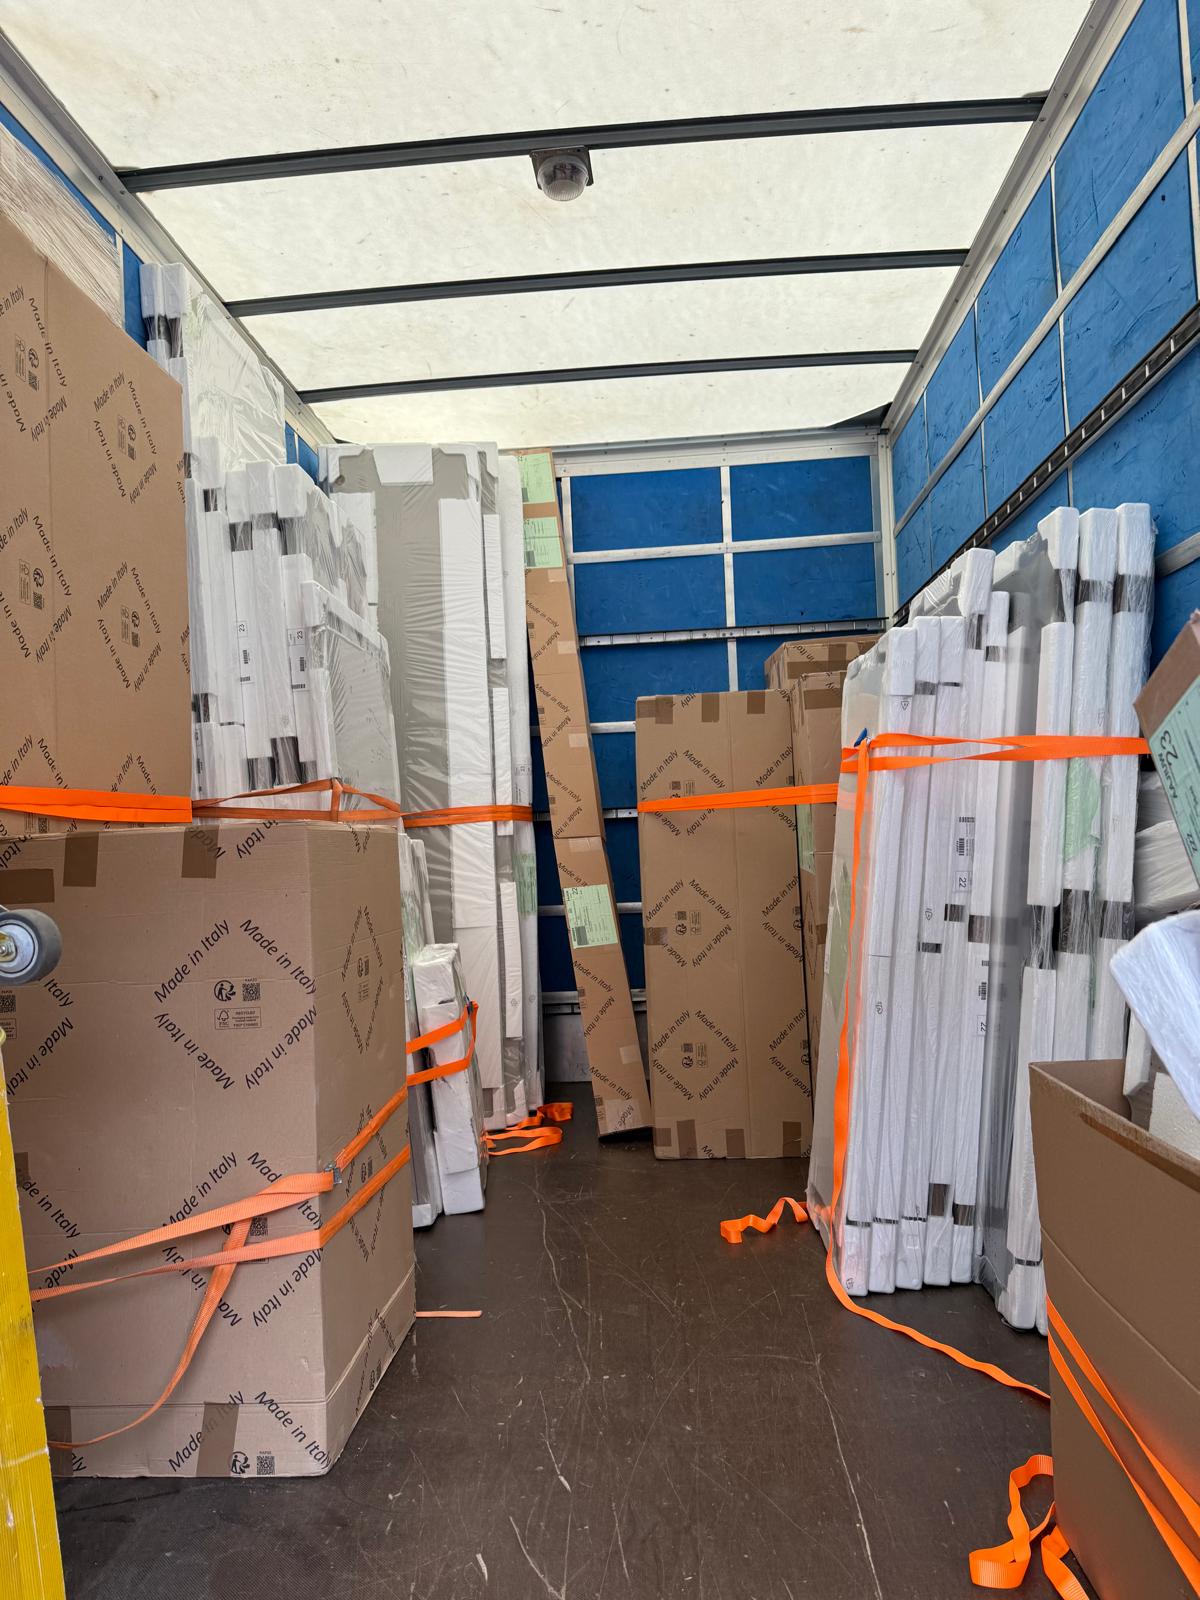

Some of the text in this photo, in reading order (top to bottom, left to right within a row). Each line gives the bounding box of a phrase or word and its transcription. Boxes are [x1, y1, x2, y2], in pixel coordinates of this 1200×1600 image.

[10, 284, 24, 305] Italy
[28, 298, 47, 339] Made
[51, 358, 67, 388] Italy
[94, 391, 109, 412] Made
[113, 370, 125, 392] Italy
[6, 390, 26, 433] Made
[49, 396, 68, 419] Made
[128, 381, 142, 414] Made
[145, 430, 157, 455] Italy
[30, 422, 46, 442] Italy
[94, 420, 107, 449] Italy
[111, 463, 126, 498] Made
[13, 507, 29, 530] Italy
[33, 516, 52, 552] Made
[56, 569, 72, 598] Italy
[97, 584, 114, 611] Made
[116, 562, 128, 584] Italy
[130, 567, 146, 599] Made
[149, 612, 162, 635] Italy
[10, 621, 32, 658] Made
[36, 605, 72, 663] Made in Italy
[97, 618, 110, 644] Italy
[114, 657, 131, 690] Made
[535, 683, 551, 698] Made
[556, 700, 570, 713] Italy
[556, 717, 571, 732] Made
[38, 738, 58, 776] Made
[121, 753, 134, 775] Italy
[1160, 730, 1178, 766] 23
[136, 755, 152, 786] Made
[640, 772, 658, 792] Made
[664, 750, 679, 765] Italy
[683, 750, 701, 768] Made
[710, 772, 726, 789] Italy
[546, 771, 561, 786] Made
[567, 789, 582, 803] Italy
[663, 820, 681, 836] Made
[686, 820, 702, 836] Italy
[778, 813, 798, 832] Made
[236, 829, 265, 859] Italy
[646, 902, 663, 922] Made
[668, 880, 684, 897] Italy
[689, 879, 709, 898] Made
[716, 903, 732, 920] Italy
[712, 924, 732, 945] Made
[762, 921, 778, 938] Italy
[153, 920, 230, 1003] Made in Italy
[239, 919, 318, 996] Made in Italy
[666, 944, 688, 967] Made
[692, 950, 708, 968] Italy
[43, 978, 73, 1008] Italy
[573, 960, 592, 978] Made
[597, 978, 614, 994] Italy
[598, 996, 615, 1015] Made
[39, 1017, 74, 1058] Made
[154, 1012, 185, 1043] Italy
[583, 1020, 596, 1039] Italy
[651, 1033, 669, 1054] Made
[676, 1010, 690, 1026] Italy
[695, 1010, 715, 1029] Made
[722, 1035, 738, 1052] Italy
[769, 1031, 789, 1051] Made
[26, 1055, 41, 1070] in
[183, 1038, 199, 1056] in
[244, 1004, 318, 1090] Made in Italy
[197, 1052, 236, 1090] Made
[652, 1059, 666, 1076] Italy
[720, 1057, 738, 1078] Made
[769, 1056, 785, 1072] Italy
[589, 1066, 609, 1084] Made
[615, 1085, 633, 1102] Italy
[673, 1080, 694, 1100] Made
[699, 1083, 715, 1100] Italy
[196, 1179, 211, 1198] in
[209, 1152, 237, 1184] Italy
[37, 1194, 53, 1213] in
[50, 1208, 81, 1239] Italy
[278, 1278, 295, 1297] in
[252, 1295, 281, 1327] Italy
[254, 1391, 293, 1428] Made
[289, 1425, 306, 1443] in
[168, 1430, 202, 1473] Made
